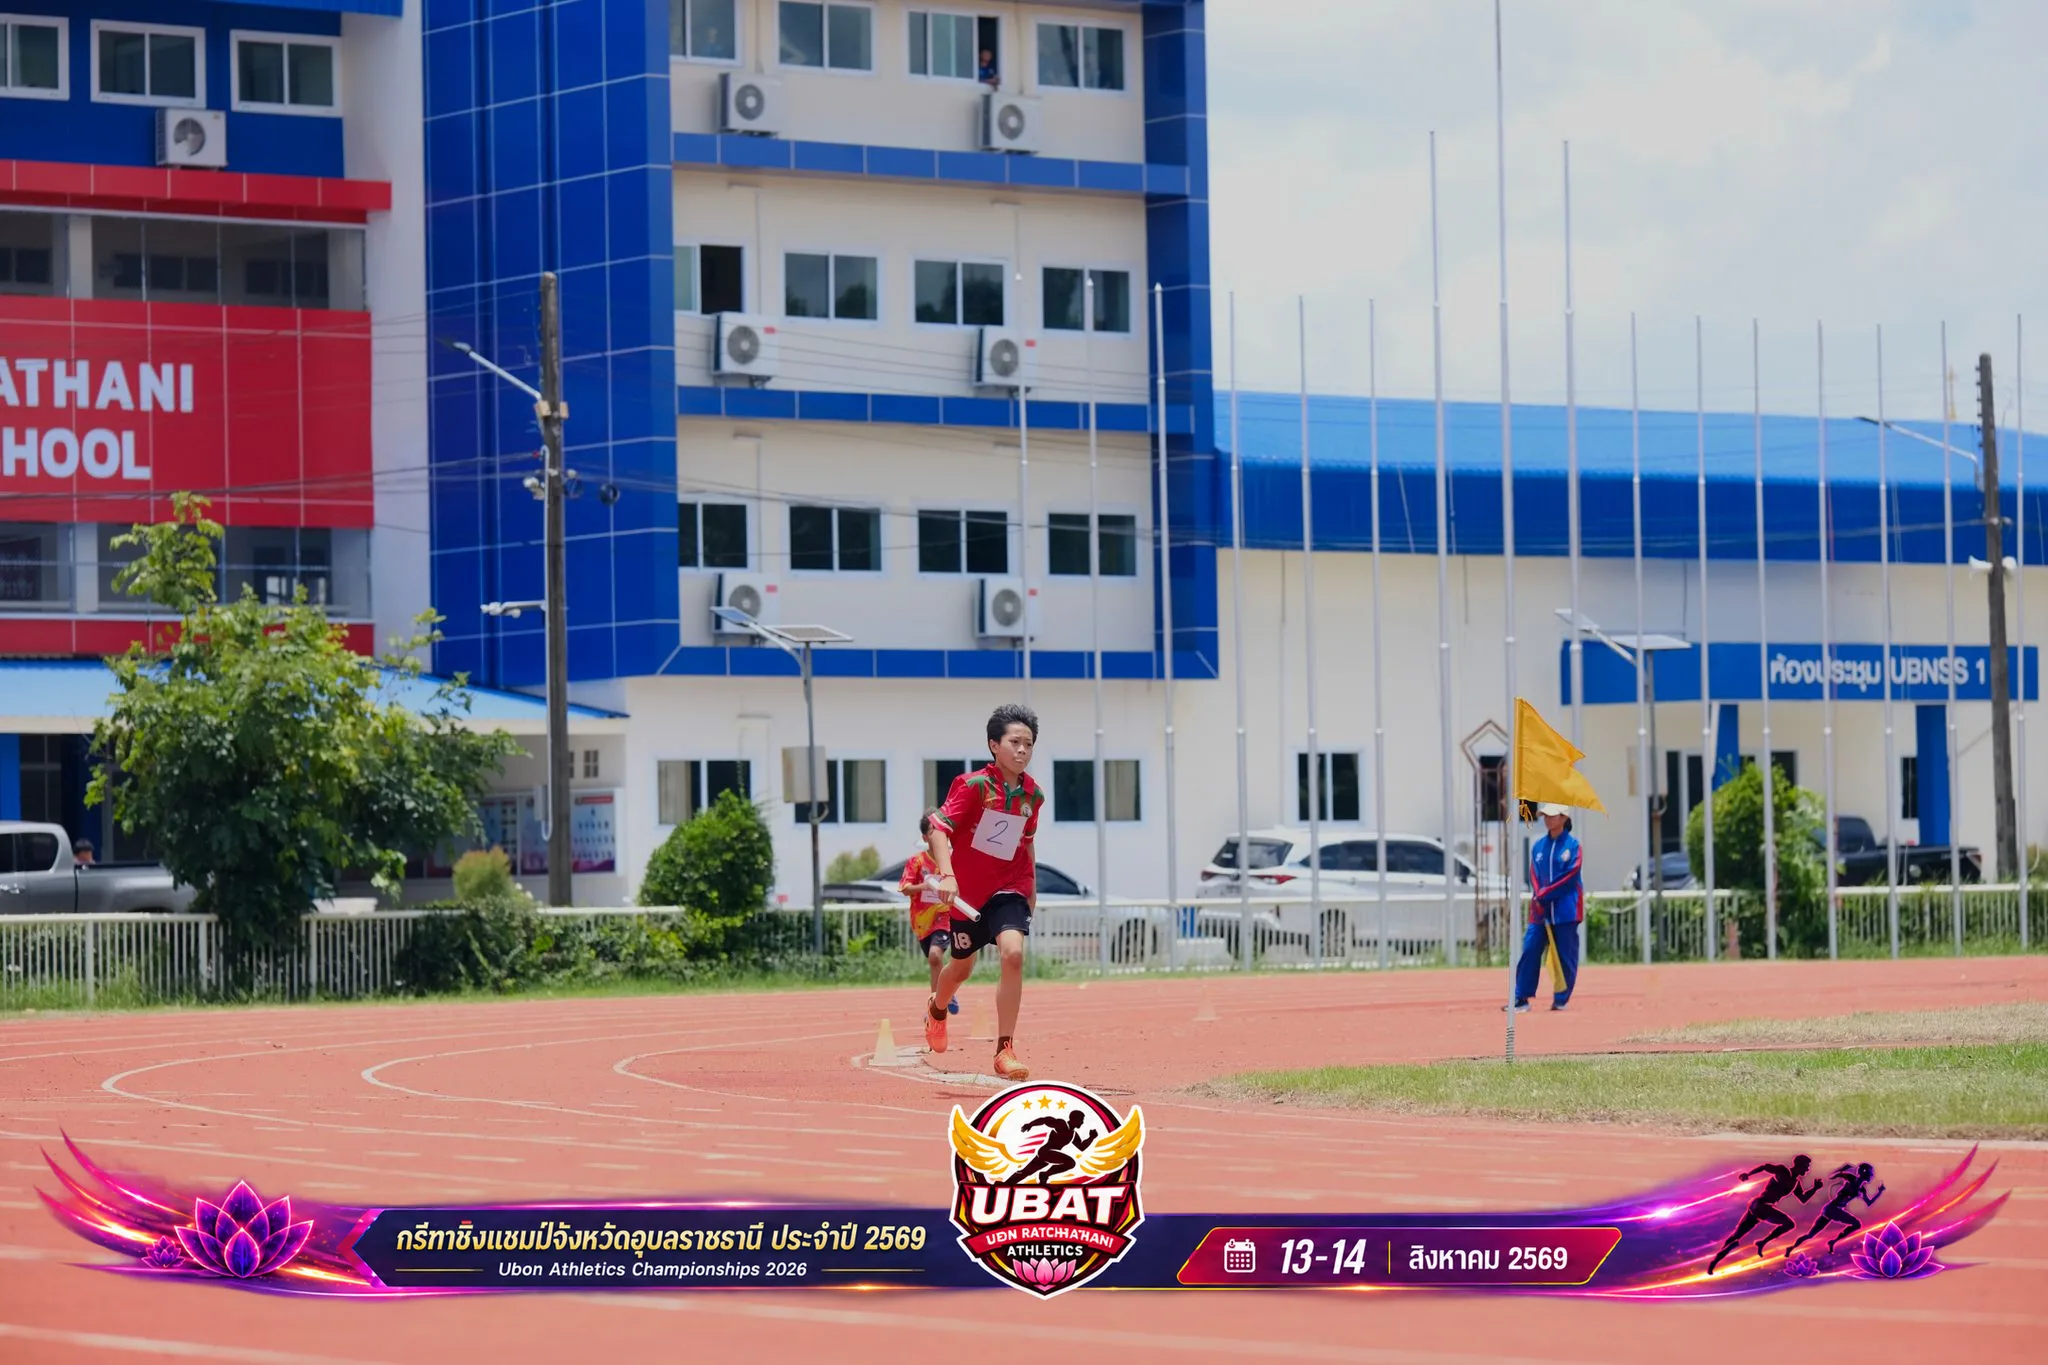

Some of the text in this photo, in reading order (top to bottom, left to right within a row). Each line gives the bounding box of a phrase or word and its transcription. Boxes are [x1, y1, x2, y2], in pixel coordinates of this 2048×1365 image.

[1890, 657, 1969, 685] UBNSS
[1976, 658, 1986, 685] 1
[986, 820, 1009, 845] 2
